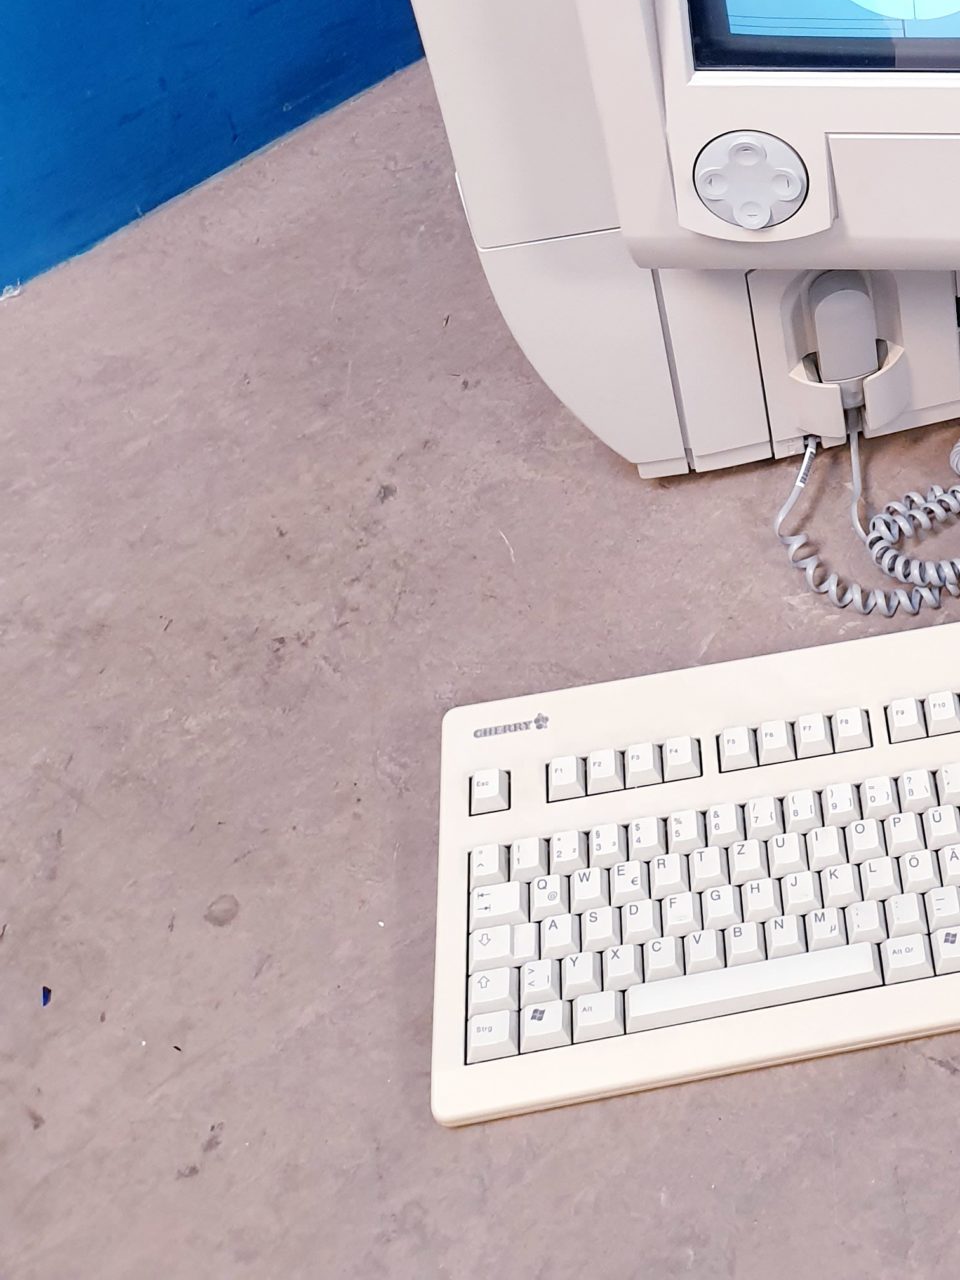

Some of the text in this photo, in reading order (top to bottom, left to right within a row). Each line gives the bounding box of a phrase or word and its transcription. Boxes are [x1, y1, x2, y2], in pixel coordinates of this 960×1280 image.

[473, 719, 533, 739] CHERRY
[669, 747, 679, 755] F4
[592, 760, 602, 768] F2
[476, 780, 490, 788] Esc
[869, 795, 876, 803] 0
[831, 802, 838, 810] 9
[753, 815, 760, 824] 7
[892, 816, 902, 827] P
[932, 809, 942, 823] Ü
[714, 822, 720, 830] 6
[854, 823, 865, 834] O
[674, 829, 681, 838] 5
[635, 836, 642, 844] 4
[775, 837, 785, 848] U
[595, 843, 602, 851] 3
[737, 844, 746, 855] Z
[556, 850, 563, 858] 2
[696, 851, 705, 862] T
[949, 847, 960, 861] Ä
[656, 858, 667, 869] R
[908, 854, 920, 868] Ö
[616, 864, 626, 876] E
[868, 862, 877, 873] L
[578, 871, 592, 883] W
[828, 868, 839, 880] K
[536, 878, 548, 890] Q
[790, 876, 798, 887] J
[750, 882, 761, 894] H
[710, 889, 721, 901] G
[669, 897, 677, 909] F
[629, 904, 639, 916] D
[588, 911, 598, 923] S
[814, 911, 826, 923] M
[548, 919, 558, 931] A
[774, 919, 784, 930] N
[733, 926, 743, 938] B
[692, 933, 702, 945] V
[651, 941, 662, 952] C
[610, 948, 620, 960] X
[569, 956, 579, 967] Y
[476, 1025, 493, 1033] Strg
